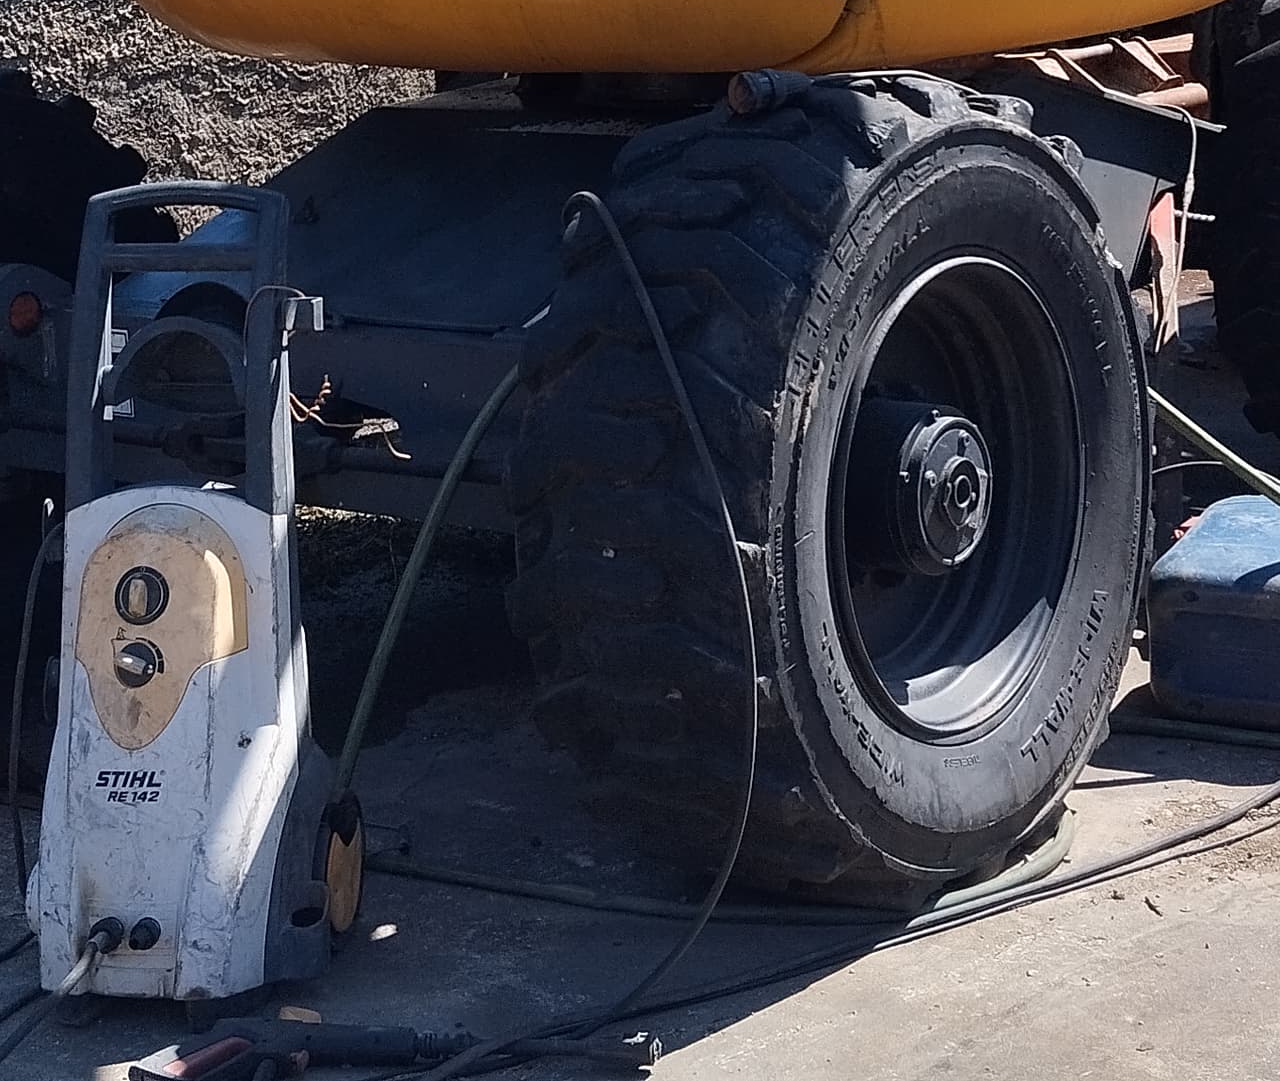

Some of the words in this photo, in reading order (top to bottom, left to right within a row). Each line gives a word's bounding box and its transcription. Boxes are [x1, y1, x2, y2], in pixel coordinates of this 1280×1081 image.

[95, 770, 162, 788] STIHL
[107, 790, 129, 802] RE
[131, 790, 160, 802] 142
